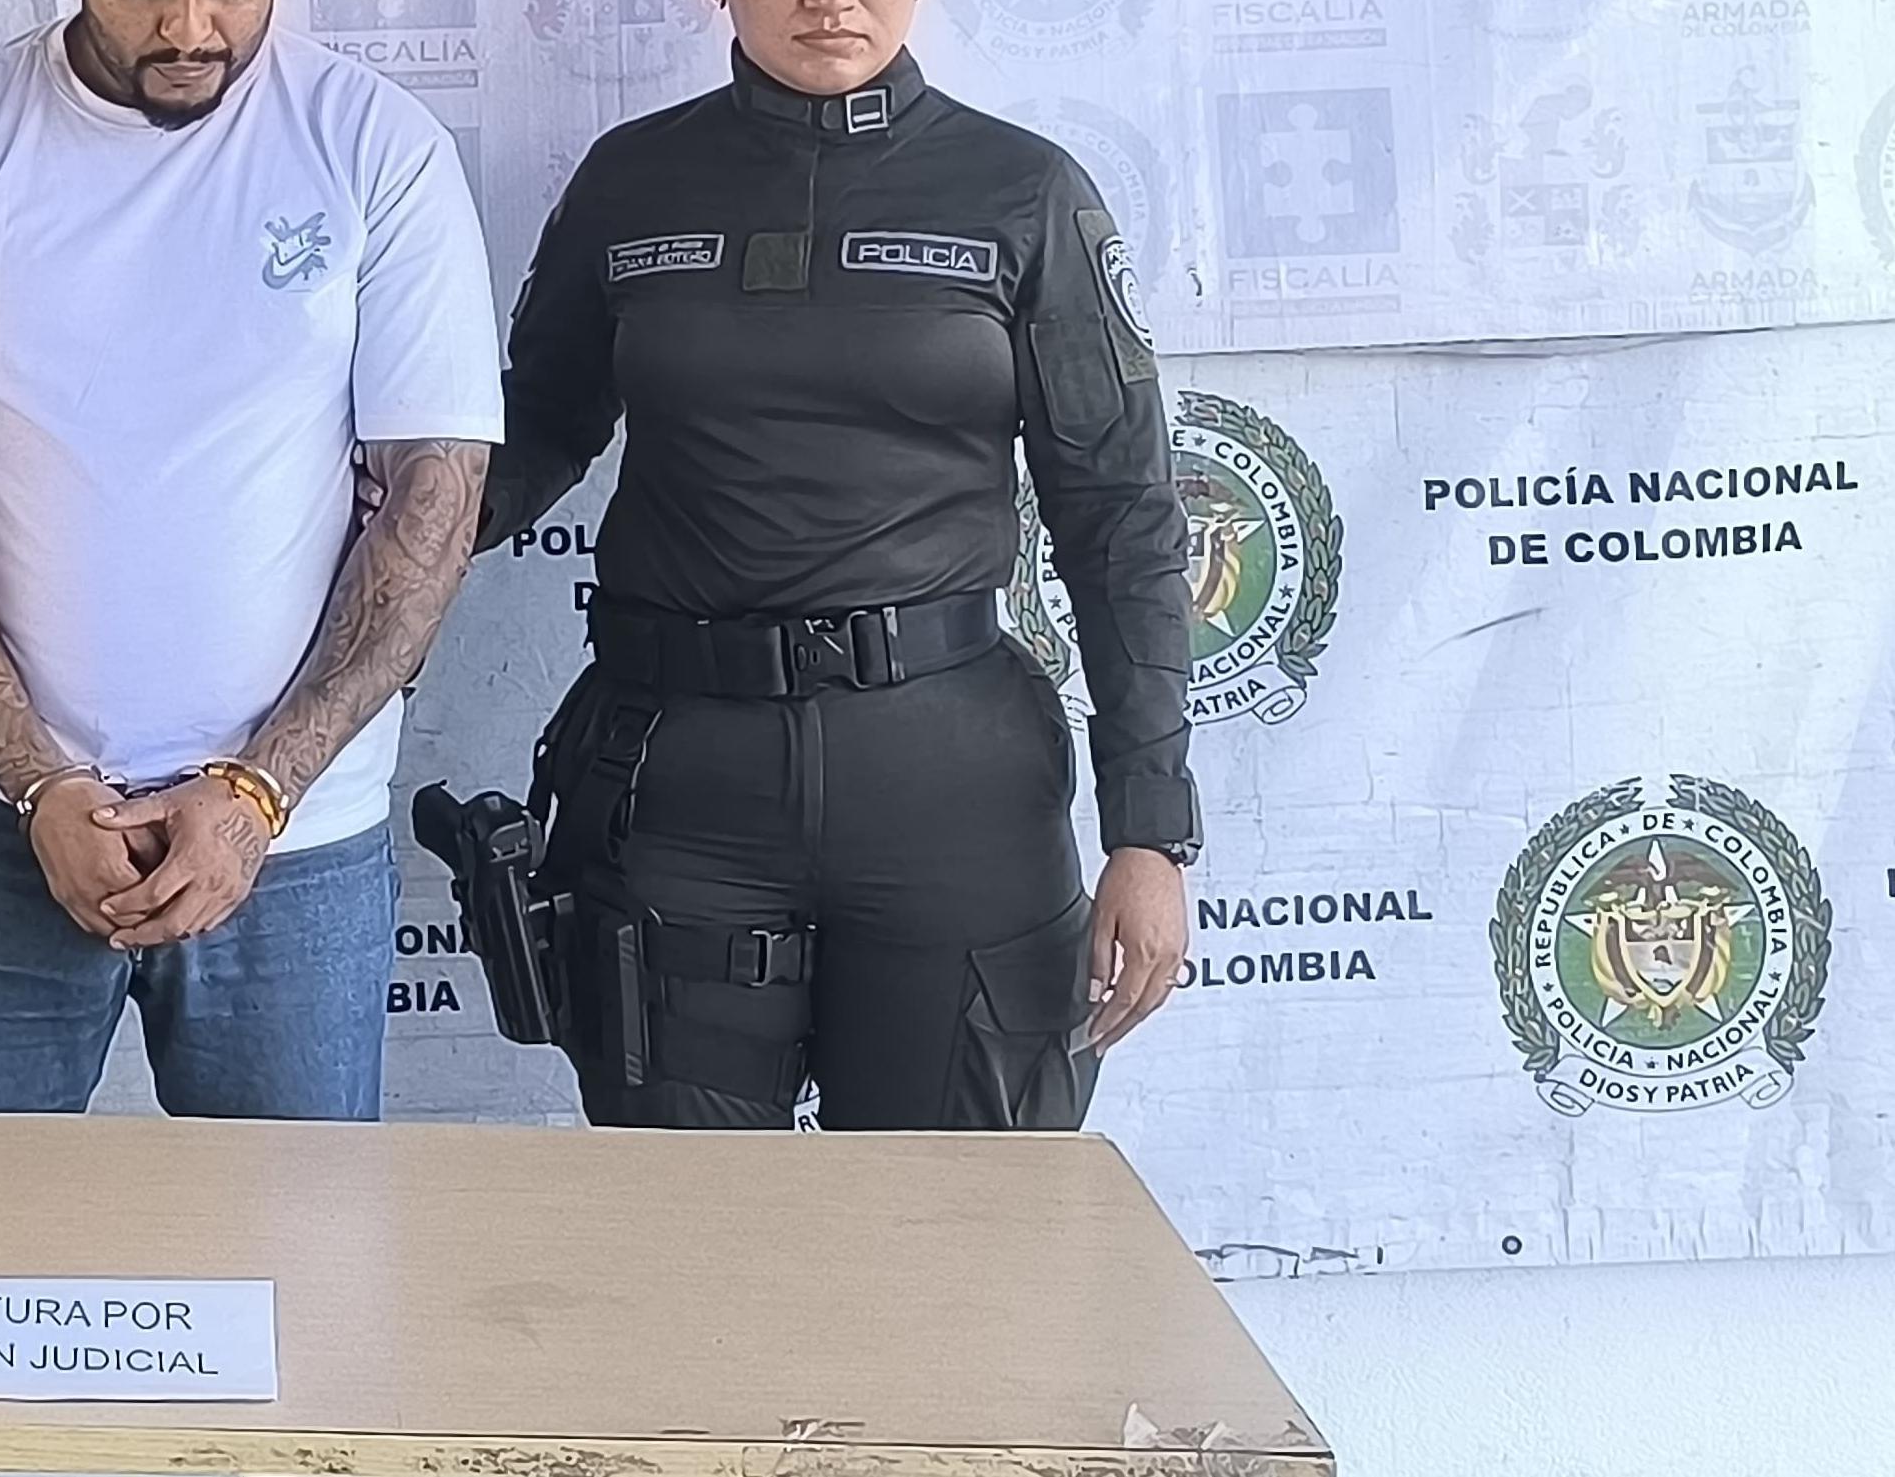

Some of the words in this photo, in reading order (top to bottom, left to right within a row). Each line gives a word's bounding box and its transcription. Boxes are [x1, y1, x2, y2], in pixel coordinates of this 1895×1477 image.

[857, 243, 979, 273] POLICÍA
[1215, 441, 1299, 571] COLOMBIA
[1424, 465, 1615, 512] POLICÍA
[1629, 460, 1861, 501] NACIONAL
[1489, 534, 1550, 567] DE
[1563, 522, 1803, 563] COLOMBIA
[1643, 811, 1676, 831] DE
[1704, 824, 1789, 956] COLOMBIA
[1197, 889, 1433, 930] NACIONAL
[1666, 987, 1779, 1071] NACIONAL
[1666, 1063, 1754, 1103] PATRIA
[103, 1300, 193, 1331] POR
[29, 1343, 220, 1376] JUDICIAL
